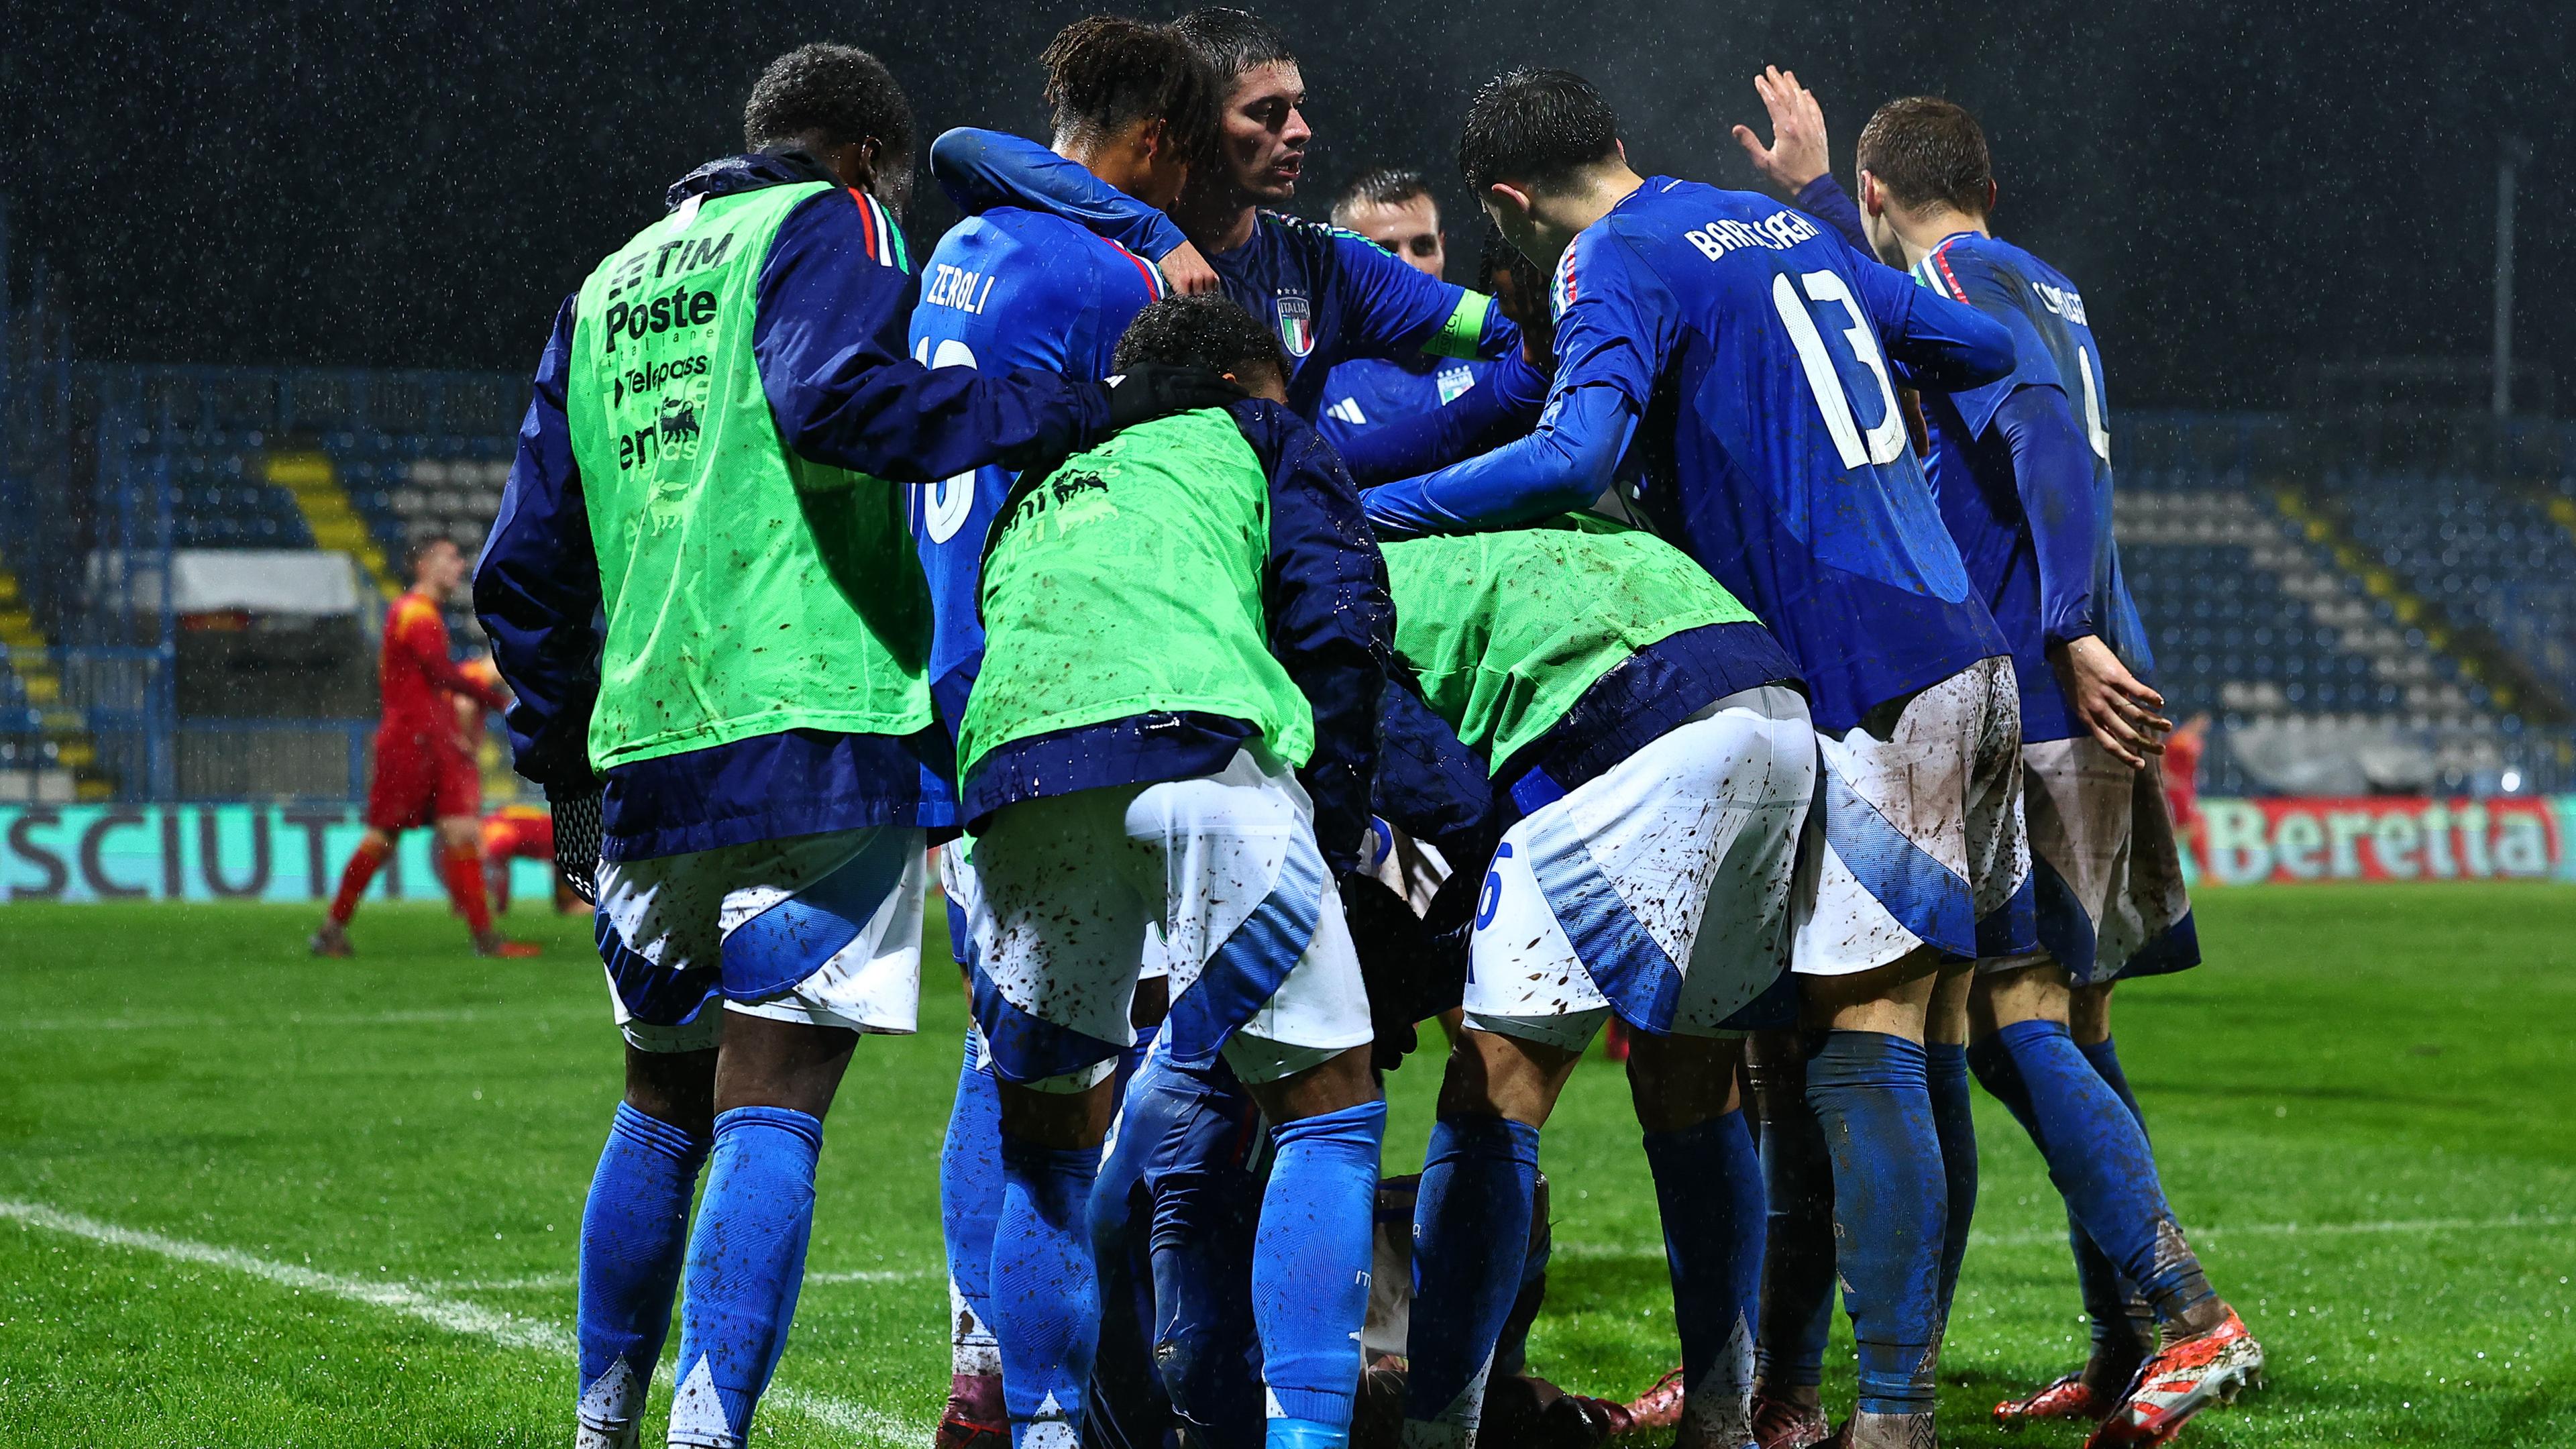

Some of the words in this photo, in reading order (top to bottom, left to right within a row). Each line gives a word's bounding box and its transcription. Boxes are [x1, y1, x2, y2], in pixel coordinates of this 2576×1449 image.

[655, 233, 734, 278] TIM
[927, 264, 995, 315] ZEROLI
[1280, 302, 1307, 315] ITALIA
[606, 285, 716, 354] Poste
[607, 329, 714, 368] italiane
[1772, 270, 1907, 470] 13
[625, 355, 708, 397] Telepass
[9, 810, 445, 898] SCIUT
[2206, 800, 2548, 883] Beretta
